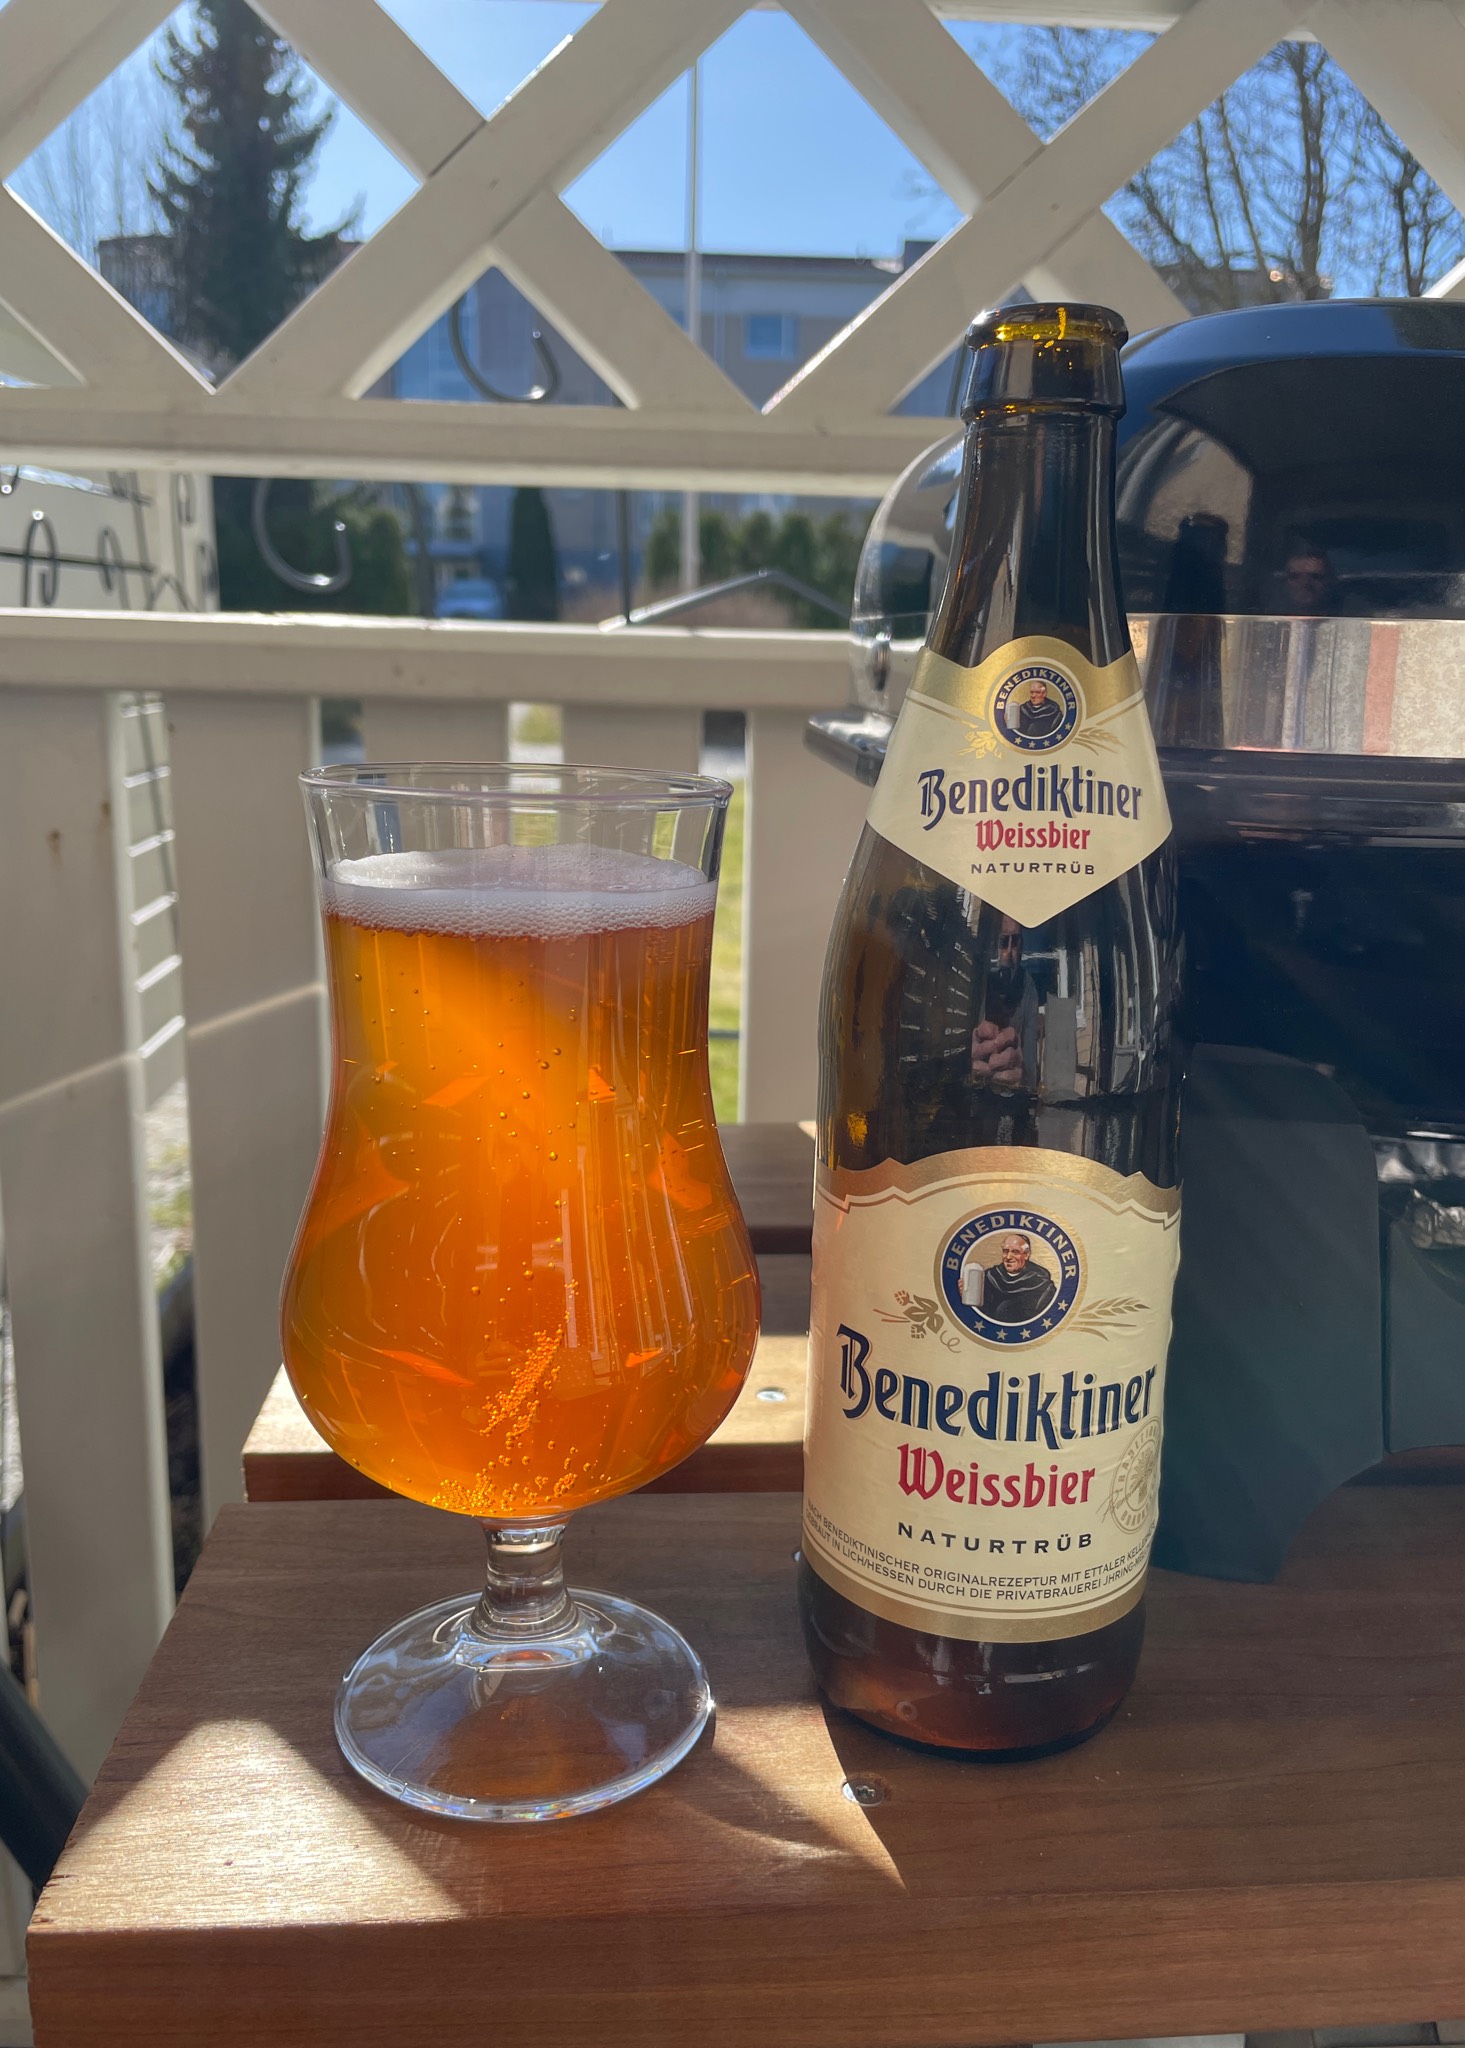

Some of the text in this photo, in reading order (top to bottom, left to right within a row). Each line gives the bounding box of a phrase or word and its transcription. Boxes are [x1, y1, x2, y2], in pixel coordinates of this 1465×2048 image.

[996, 668, 1076, 711] BENEDIKTINER
[917, 763, 1142, 831] Benediktiner
[975, 819, 1091, 851] Weissbier
[971, 861, 1095, 875] NATURTRÜB
[946, 1213, 1077, 1279] BENEDIKTINER
[836, 1323, 1157, 1450] Benediktiner
[896, 1442, 1096, 1508] Weissbier
[823, 1516, 920, 1575] BENEDIKTINISCHER
[923, 1566, 1057, 1588] ORIGINALREZEPTUR
[1061, 1571, 1081, 1585] MIT
[1084, 1555, 1126, 1579] ETTALER
[831, 1538, 841, 1552] IN
[842, 1547, 914, 1586] LICH/HESSEN
[918, 1578, 965, 1597] DURCH
[969, 1587, 992, 1600] DIE
[996, 1578, 1102, 1601] PRIVATBRAUEREI
[897, 1521, 1093, 1555] NATURTRÜB
